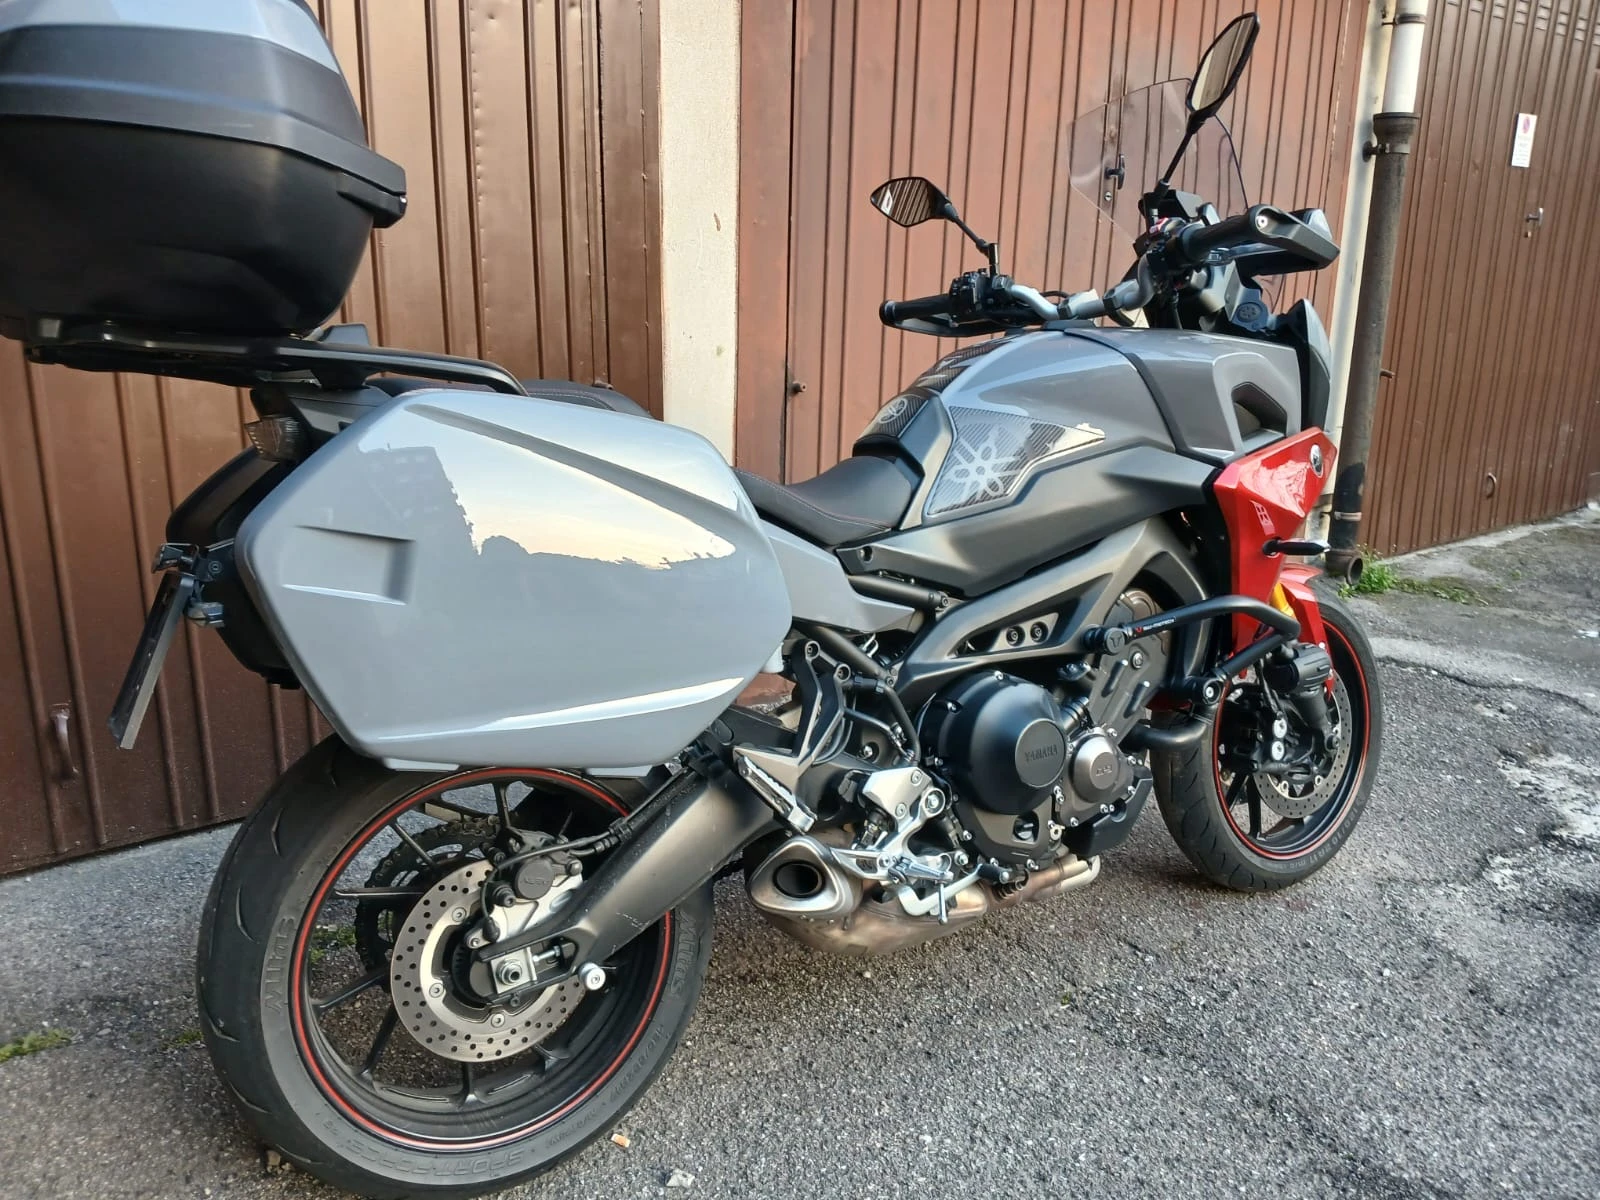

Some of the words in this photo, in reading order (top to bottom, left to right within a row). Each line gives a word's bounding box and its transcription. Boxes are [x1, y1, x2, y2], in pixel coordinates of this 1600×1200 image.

[1024, 743, 1058, 763] YAMAHA
[263, 915, 296, 1014] Mitas
[669, 907, 697, 994] Mitas
[434, 1148, 527, 1178] SPORT
